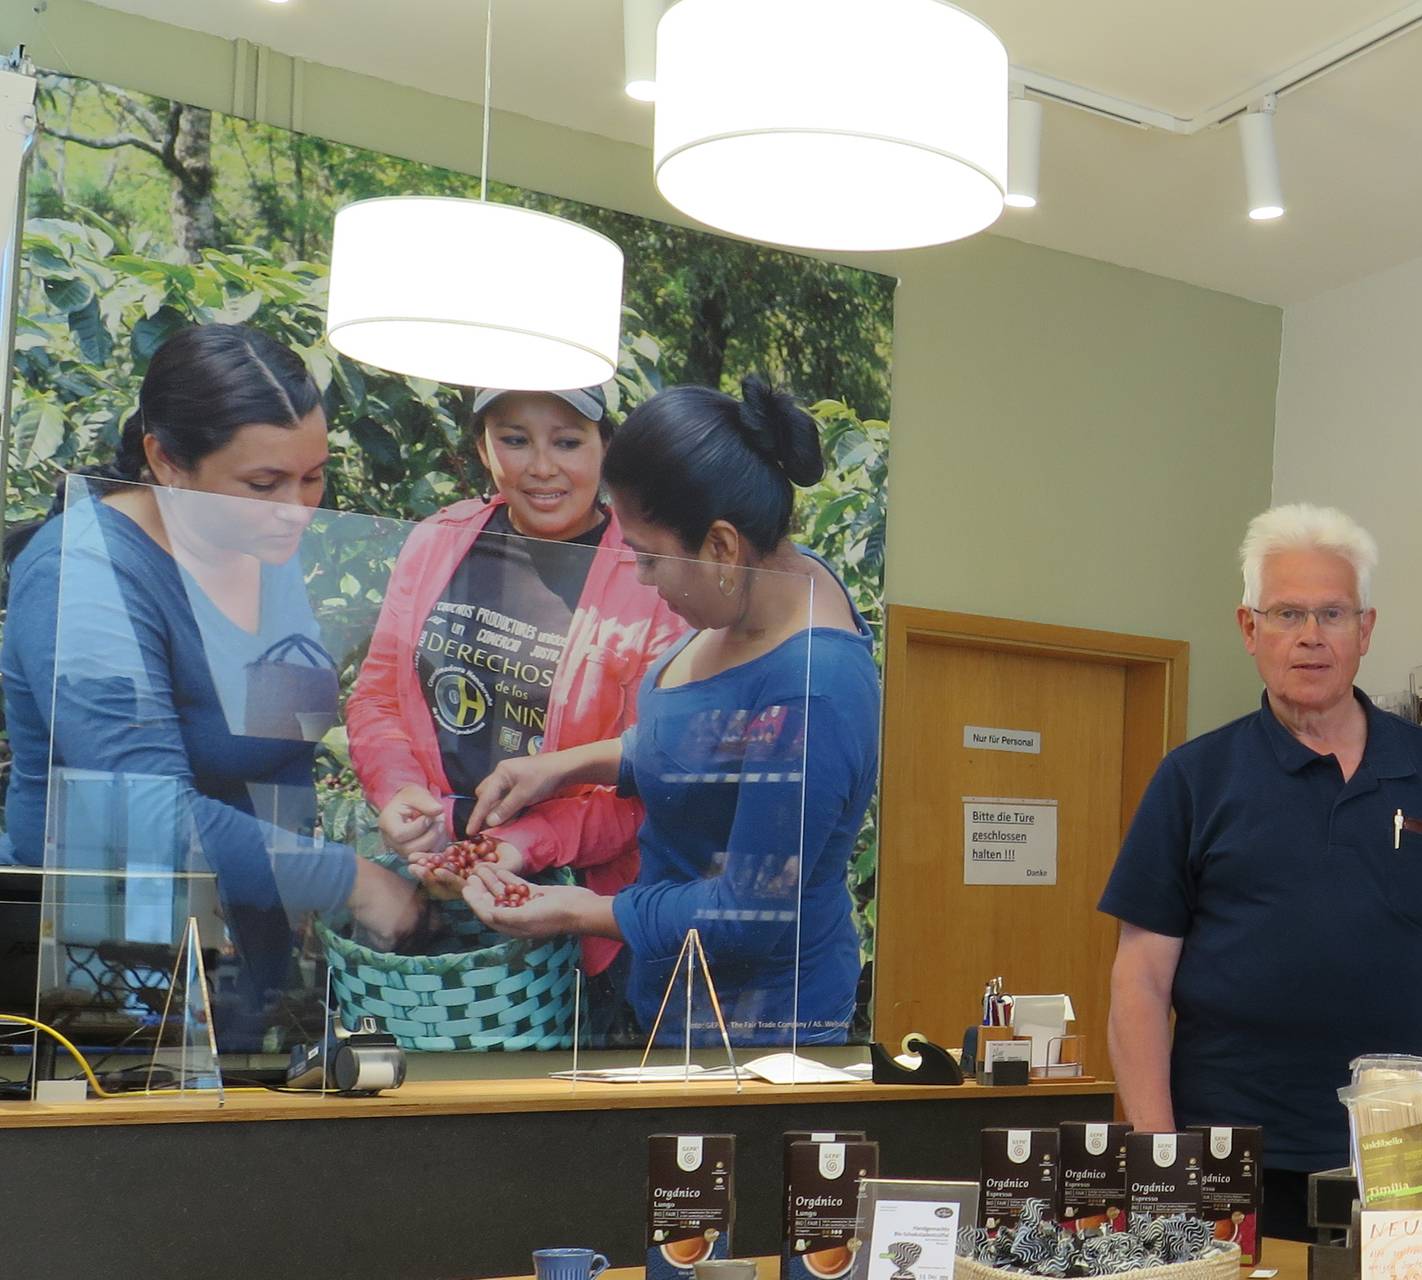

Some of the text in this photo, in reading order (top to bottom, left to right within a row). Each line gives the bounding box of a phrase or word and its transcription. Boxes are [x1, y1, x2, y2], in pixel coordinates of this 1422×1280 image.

[427, 632, 554, 687] DERECHOS
[495, 681, 528, 699] de los
[973, 734, 1034, 747] Nur für Personal
[972, 811, 1035, 823] Bitte die Türe
[972, 831, 1027, 842] geschlossen
[972, 849, 1015, 860] halten !!!
[1026, 869, 1047, 877] Danke
[758, 1021, 776, 1029] Trade
[1065, 1169, 1106, 1181] Orgánico
[986, 1178, 1029, 1190] Orgánico
[1132, 1182, 1175, 1195] Orgánico
[654, 1187, 701, 1200] Orgánico
[796, 1196, 843, 1209] Orgánico
